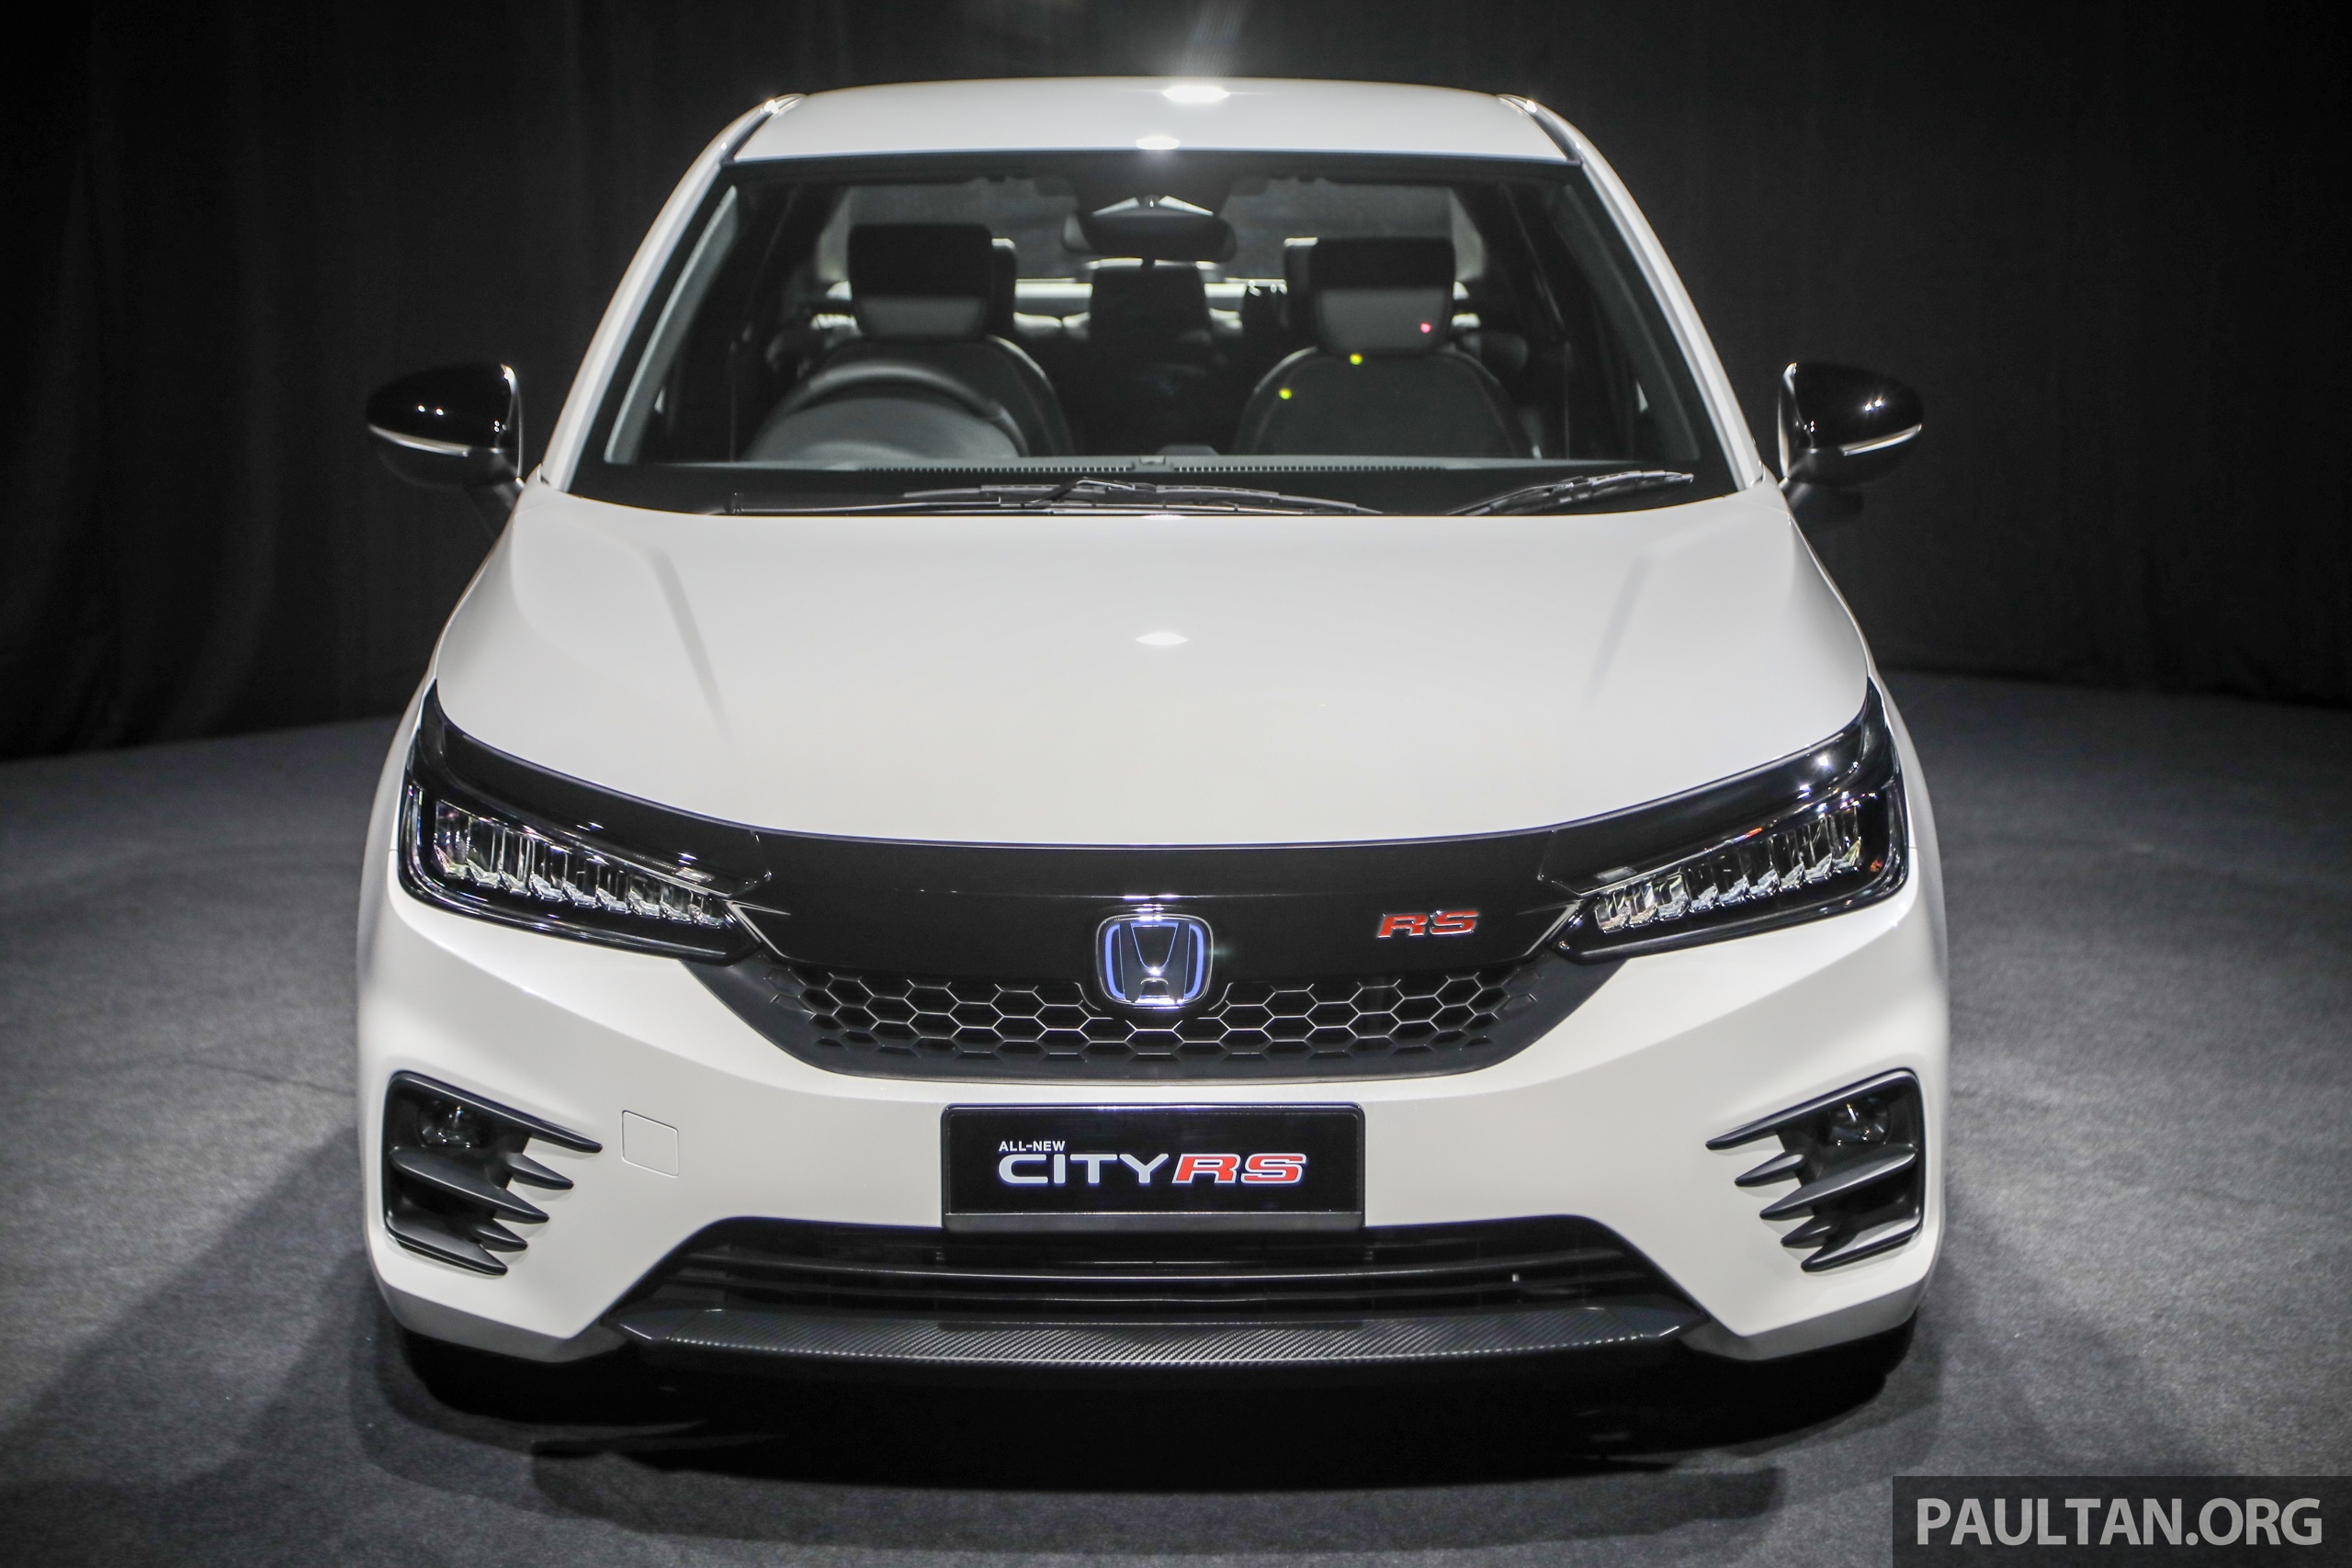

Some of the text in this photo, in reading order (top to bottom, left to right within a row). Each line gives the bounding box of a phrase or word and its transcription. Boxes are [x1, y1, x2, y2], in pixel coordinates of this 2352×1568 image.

[1377, 910, 1478, 938] RS
[998, 1140, 1066, 1152] ALL-NEW
[998, 1153, 1307, 1185] CITY RS
